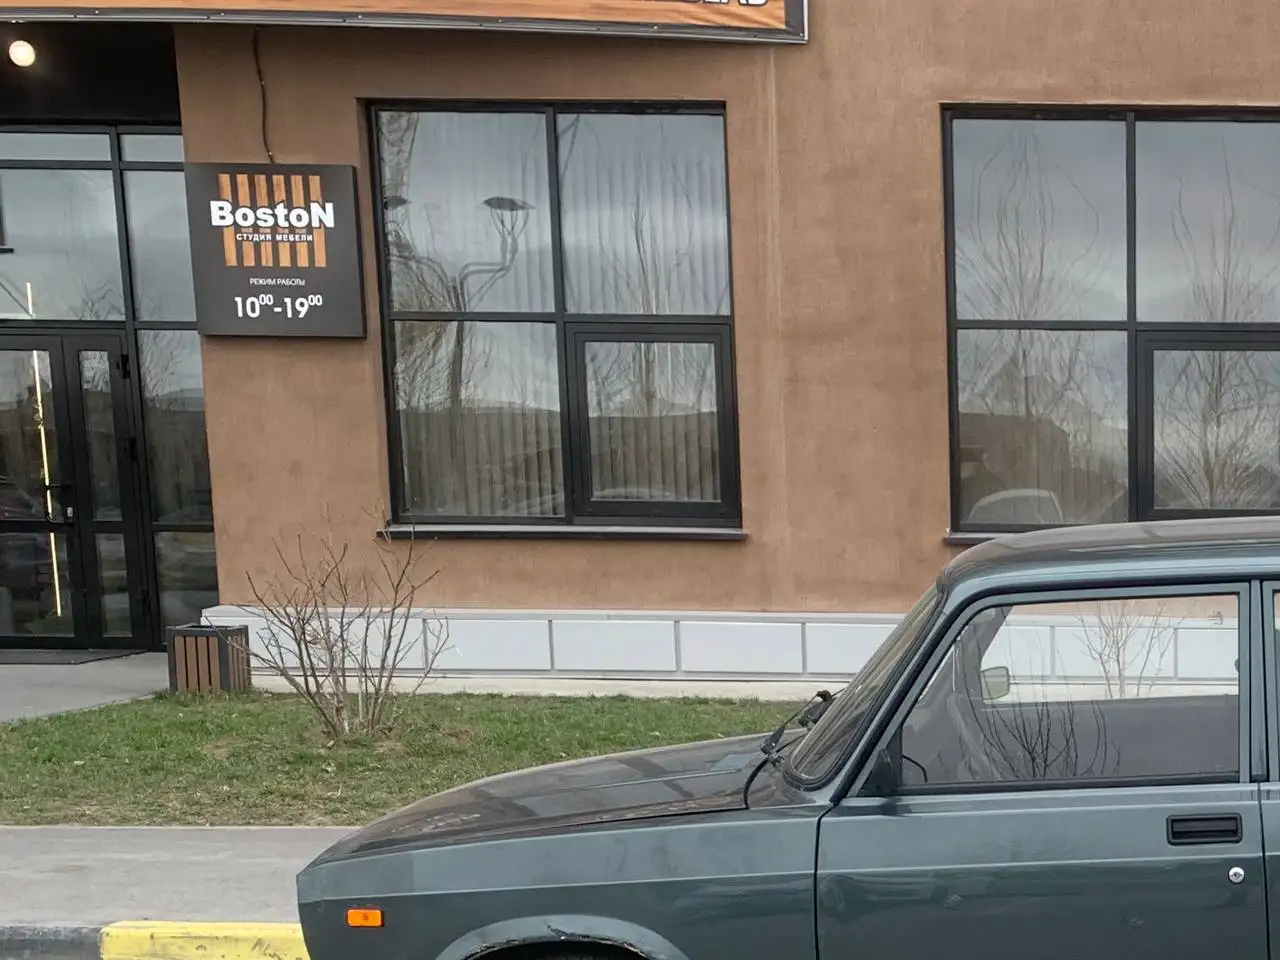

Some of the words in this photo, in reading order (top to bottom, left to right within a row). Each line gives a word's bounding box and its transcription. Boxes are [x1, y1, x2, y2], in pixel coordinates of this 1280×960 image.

[209, 200, 335, 228] BostoN
[236, 233, 272, 242] СТУДИЯ
[275, 233, 313, 242] МЕБЕЛИ
[249, 278, 276, 286] РЕЖИМ
[277, 278, 306, 286] РАБОТЫ
